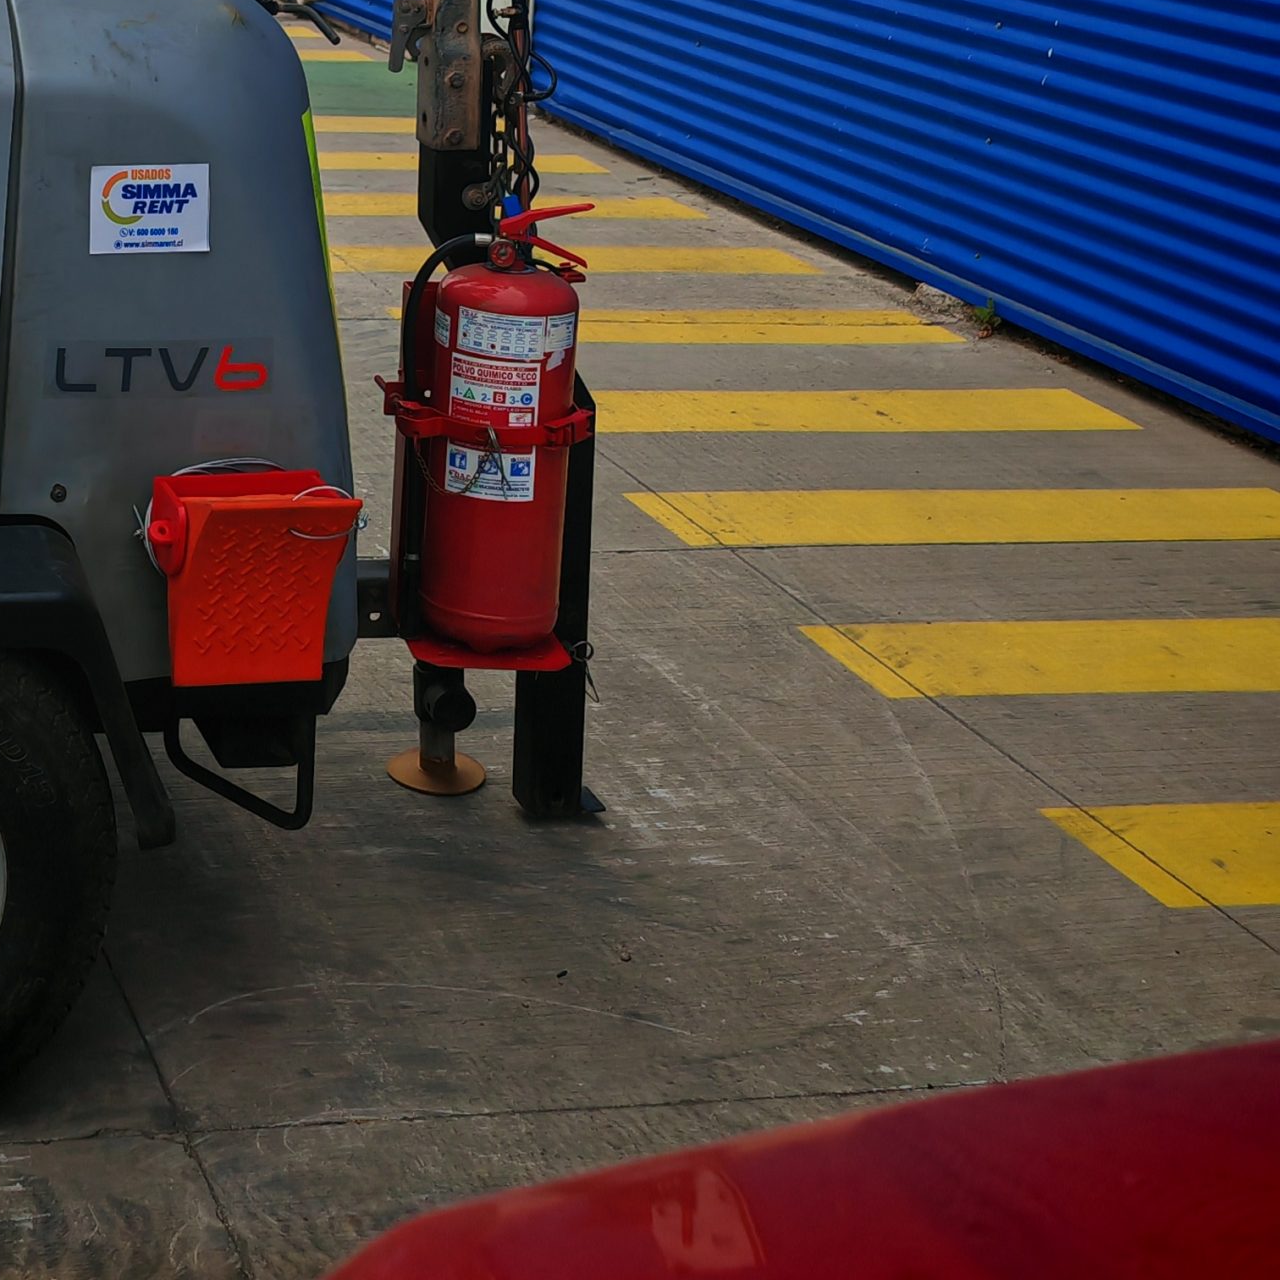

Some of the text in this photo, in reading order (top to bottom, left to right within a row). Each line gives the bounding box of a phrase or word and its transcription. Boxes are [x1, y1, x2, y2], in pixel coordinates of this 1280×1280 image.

[131, 168, 172, 181] USADOS
[121, 183, 197, 199] SIMMA
[132, 199, 189, 214] RENT
[453, 362, 537, 381] POLVO QUIMICO SECO
